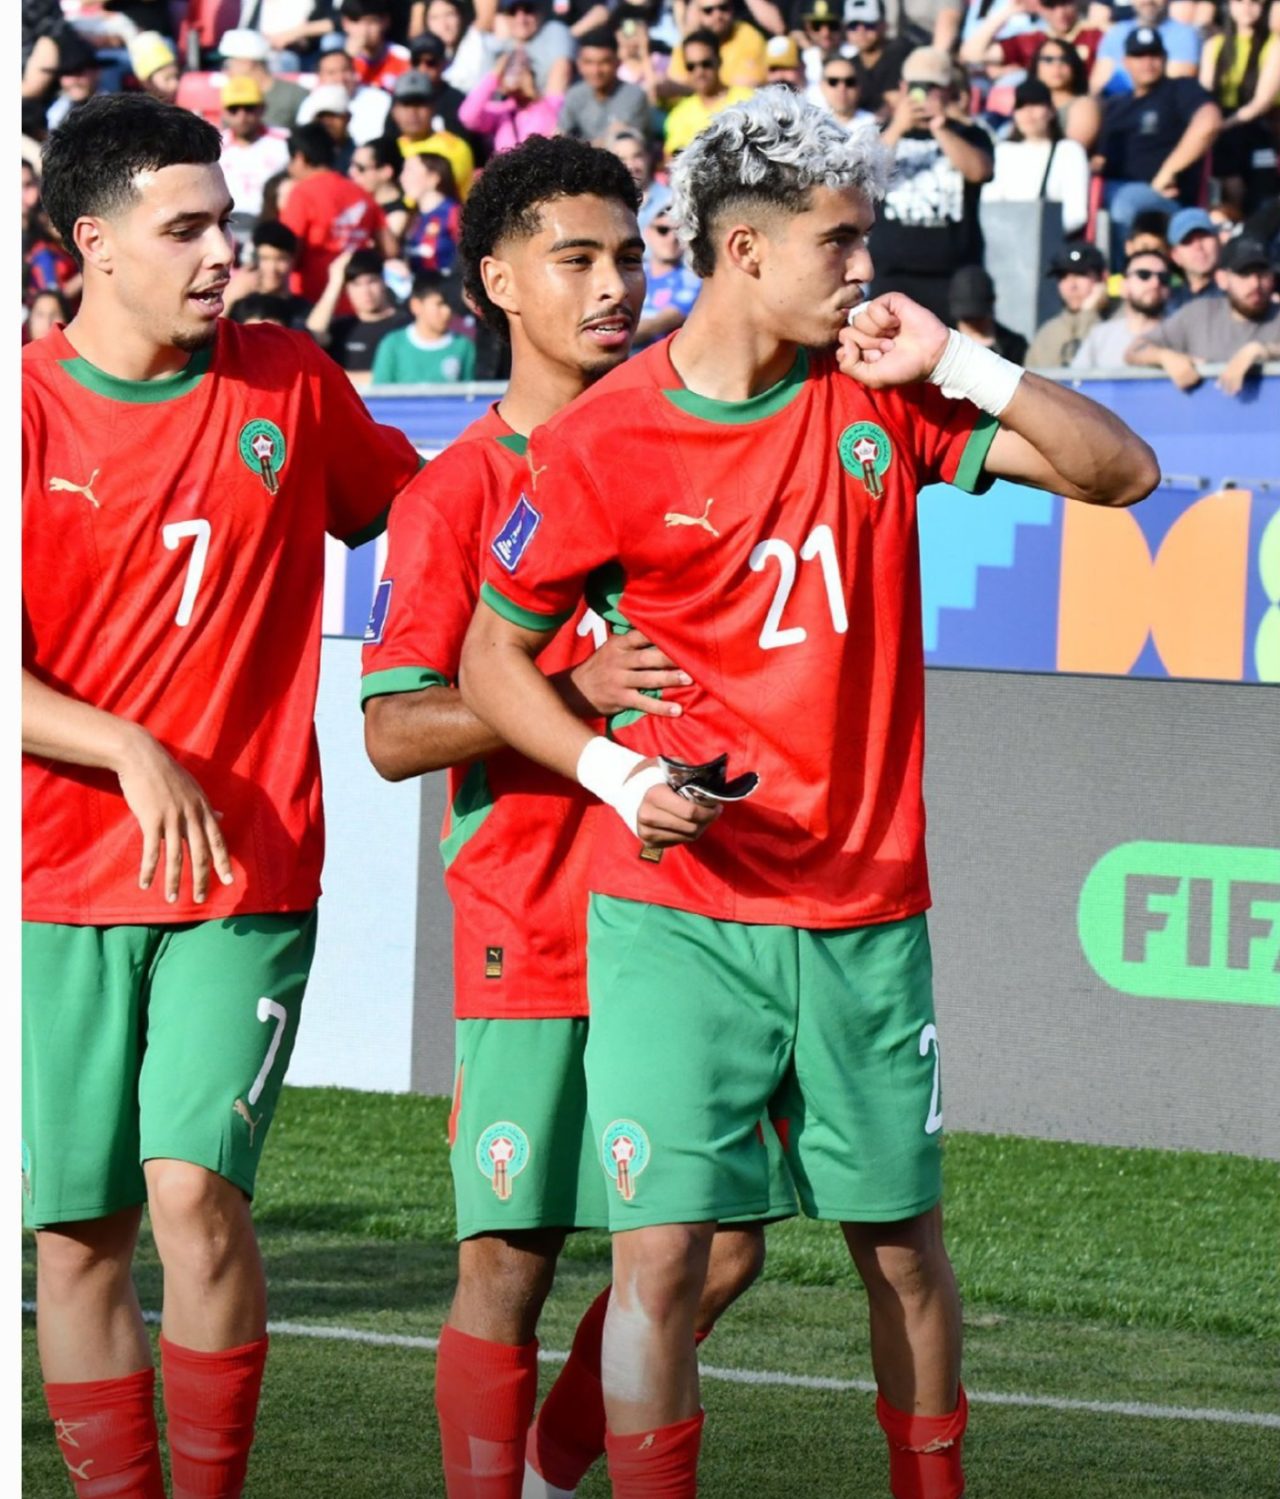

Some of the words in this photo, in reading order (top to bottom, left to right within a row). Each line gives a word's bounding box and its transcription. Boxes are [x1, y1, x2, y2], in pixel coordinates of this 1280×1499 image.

[162, 518, 212, 627] 7
[749, 524, 849, 650] 21
[1122, 874, 1280, 973] FIF
[248, 997, 287, 1105] 7
